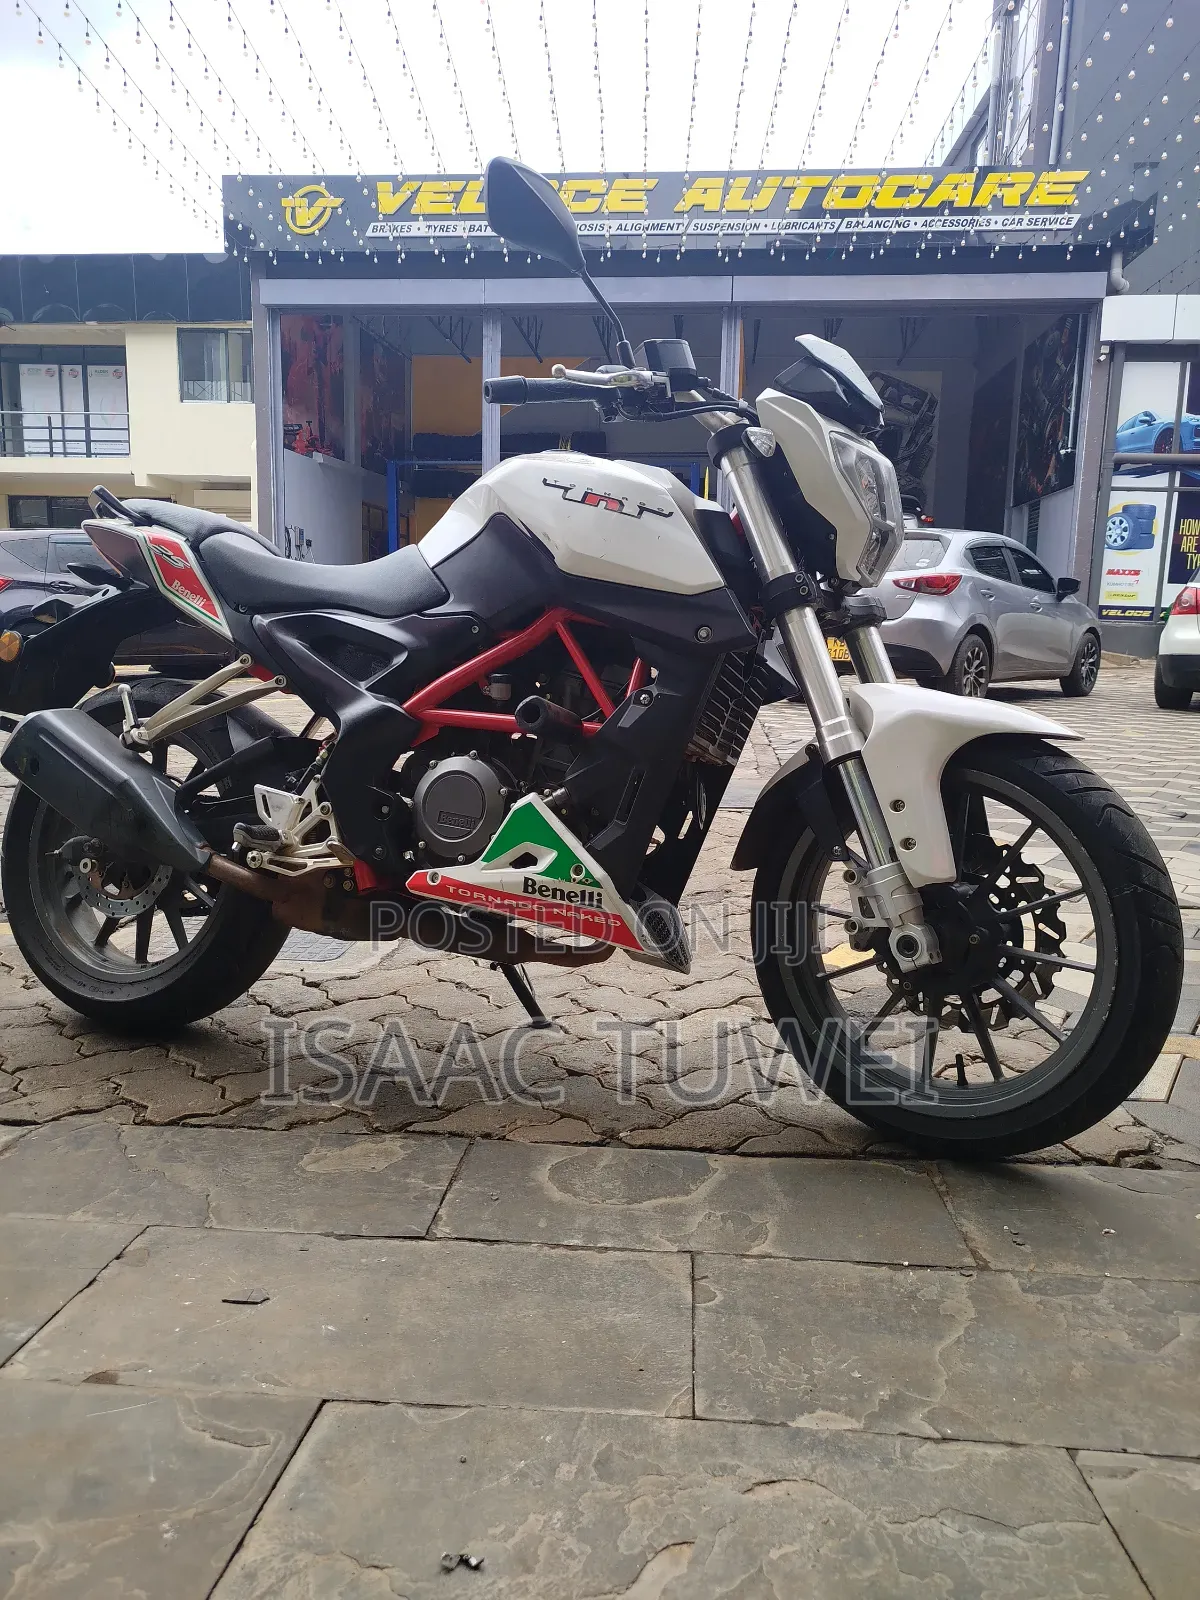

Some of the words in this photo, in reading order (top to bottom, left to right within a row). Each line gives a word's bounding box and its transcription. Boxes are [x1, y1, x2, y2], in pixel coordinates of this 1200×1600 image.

[376, 178, 660, 214] VELCE
[674, 171, 1090, 212] AUTOCARE
[371, 224, 413, 233] BRAKES
[426, 224, 458, 233] TYRES
[468, 224, 489, 233] BAT
[577, 223, 605, 232] OSIS
[615, 222, 682, 232] ALIGNMENT
[692, 222, 761, 232] SUSPENSION
[771, 221, 836, 231] LUBRICANTS
[845, 219, 911, 229] BALANCING
[921, 218, 991, 229] ACCESSORIES
[1001, 217, 1024, 227] CAR
[1026, 216, 1075, 227] SERVICE
[1180, 536, 1199, 553] ARE
[171, 580, 206, 607] Benelli
[1102, 609, 1152, 617] VELOCE
[446, 885, 545, 912] TORNADO
[553, 909, 621, 927] NAKED
[523, 876, 603, 909] Benelli
